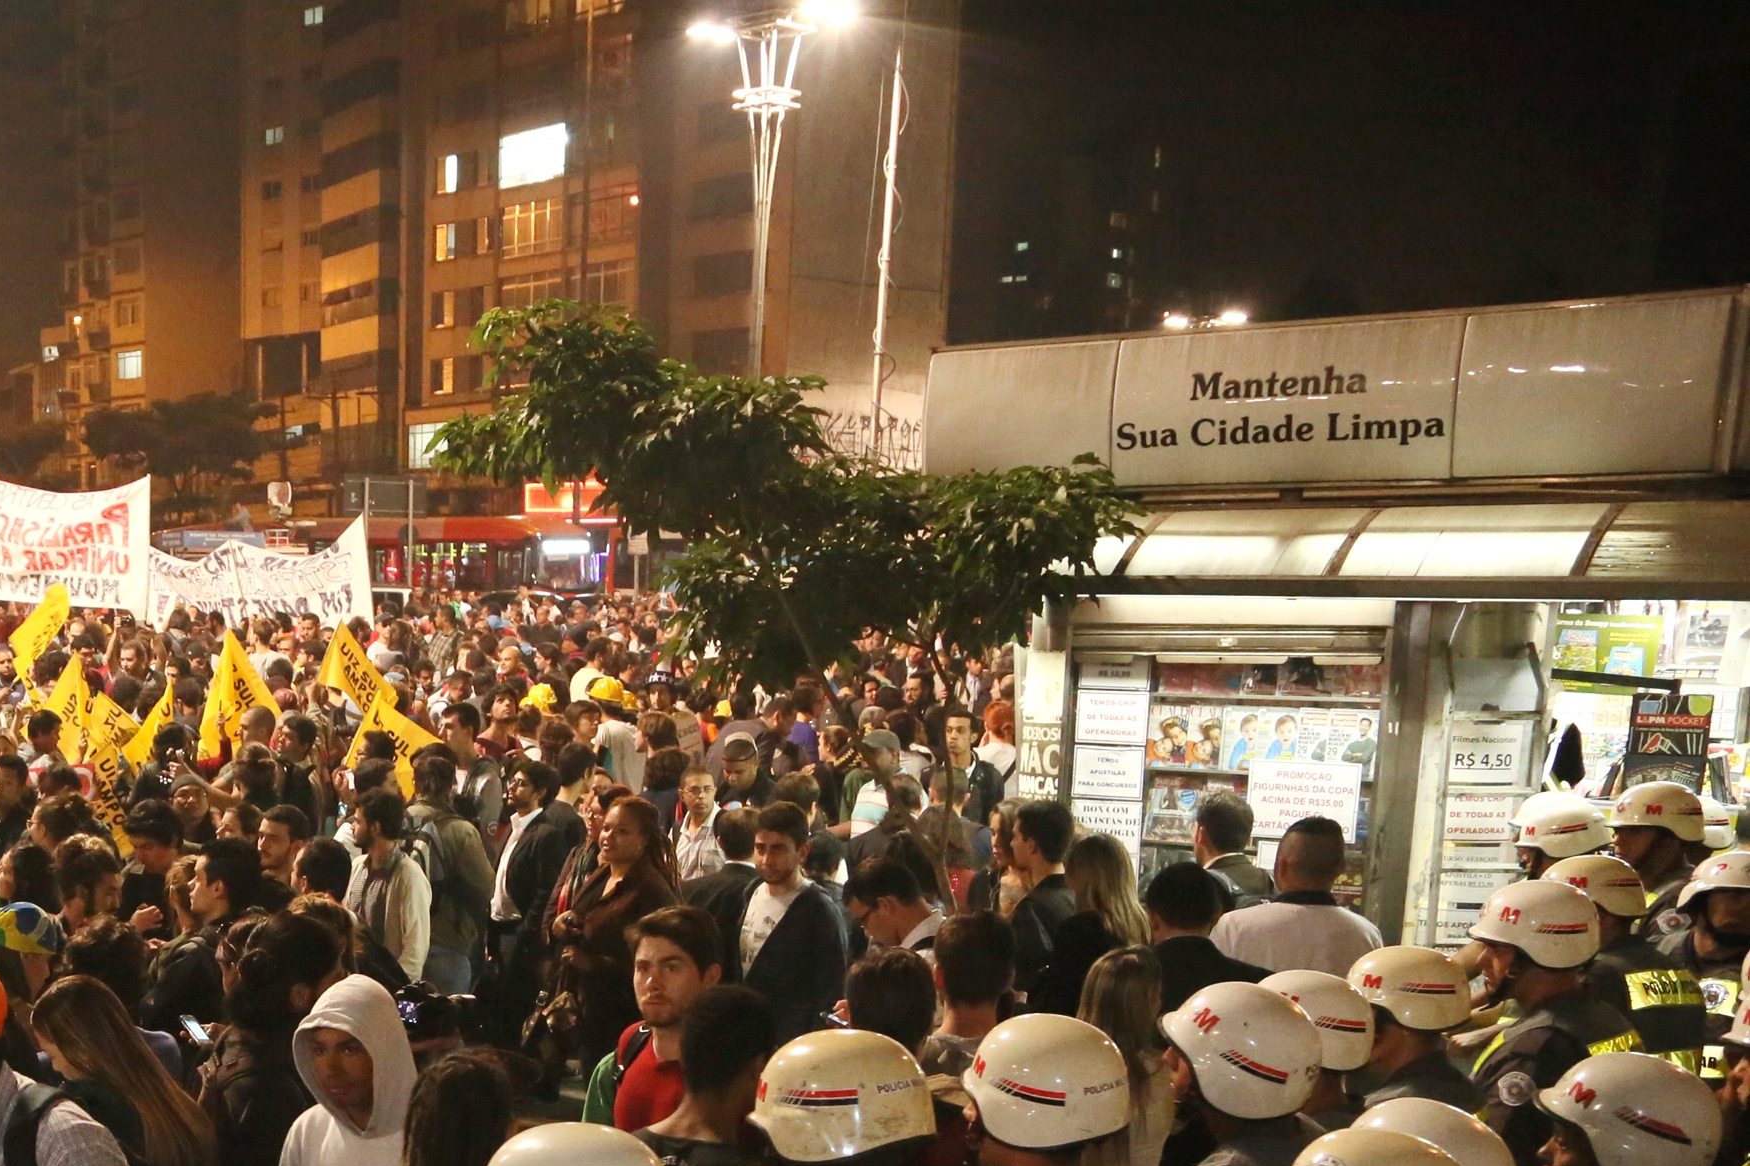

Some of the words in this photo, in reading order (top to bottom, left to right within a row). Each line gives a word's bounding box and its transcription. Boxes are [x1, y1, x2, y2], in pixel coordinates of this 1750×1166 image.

[1190, 366, 1367, 400] Mantenha
[1116, 423, 1178, 450] Sua
[1191, 414, 1314, 446] Cidade
[1327, 413, 1445, 445] Limpa
[1090, 699, 1117, 707] TEMOS
[1087, 713, 1098, 721] DE
[1099, 714, 1125, 722] TODAS
[1126, 714, 1138, 722] AS
[1667, 716, 1705, 725] POCKET
[1085, 728, 1137, 737] OPERADORAS
[1452, 735, 1480, 743] Filmes
[1454, 753, 1475, 769] R$
[1481, 753, 1512, 770] 4,50
[1277, 770, 1332, 782] PROMOÇÃO
[1253, 782, 1309, 794] FIGURINHAS
[1312, 785, 1326, 794] DA
[1328, 786, 1354, 795] COPA
[1261, 796, 1291, 805] ACIMA
[1293, 797, 1306, 806] DE
[1309, 797, 1344, 810] R$35,00
[1083, 805, 1104, 814] BOX
[1106, 806, 1129, 815] COM
[1449, 811, 1462, 819] DE
[1464, 811, 1494, 819] TODAS
[1496, 811, 1506, 819] AS
[1646, 804, 1663, 816] M
[1125, 817, 1141, 827] DE
[1446, 827, 1505, 835] OPERADORAS
[1569, 876, 1588, 889] M
[1500, 906, 1521, 925] M
[1363, 974, 1382, 989] M
[1193, 1007, 1220, 1034] M
[973, 1054, 987, 1078] M
